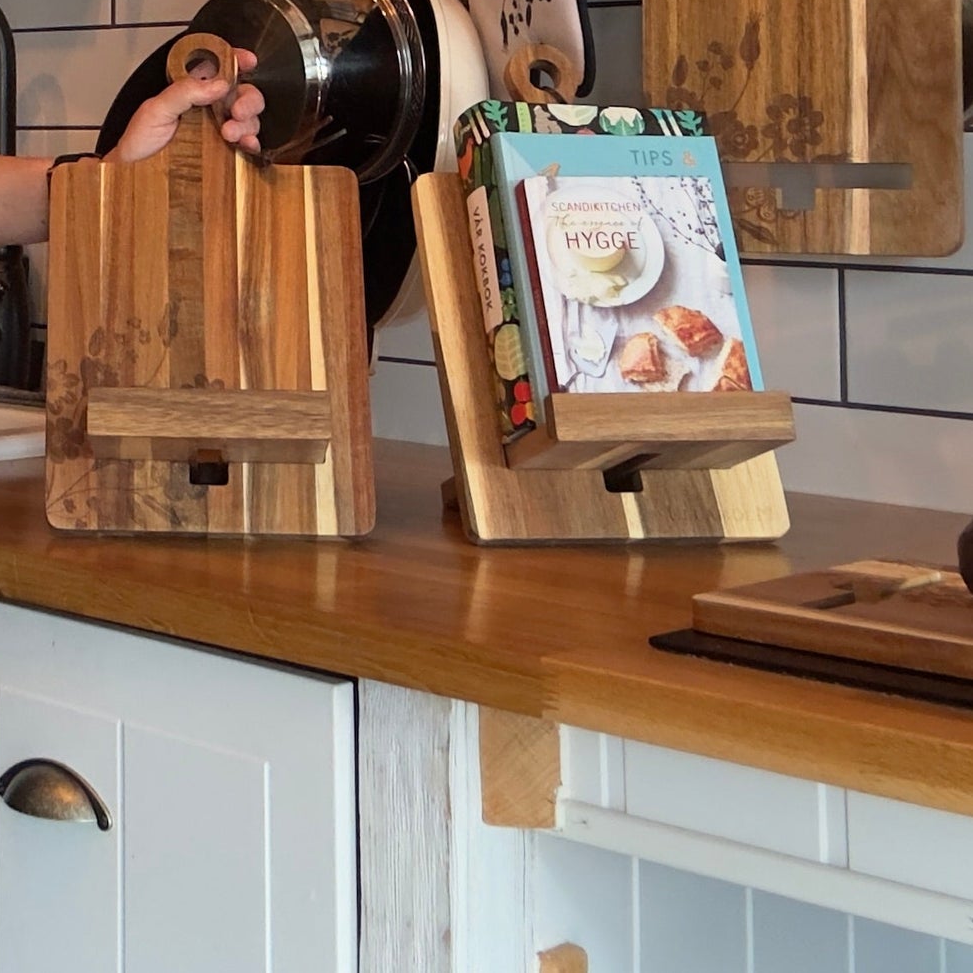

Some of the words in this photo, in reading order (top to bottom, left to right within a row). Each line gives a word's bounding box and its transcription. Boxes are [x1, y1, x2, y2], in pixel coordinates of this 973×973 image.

[629, 150, 673, 166] TIPS
[681, 150, 697, 166] &
[550, 202, 642, 213] SCANDIKITCHEN
[472, 205, 484, 239] VÅR
[547, 214, 576, 228] The
[565, 231, 641, 250] HYGGE
[477, 243, 493, 313] KOKBOK
